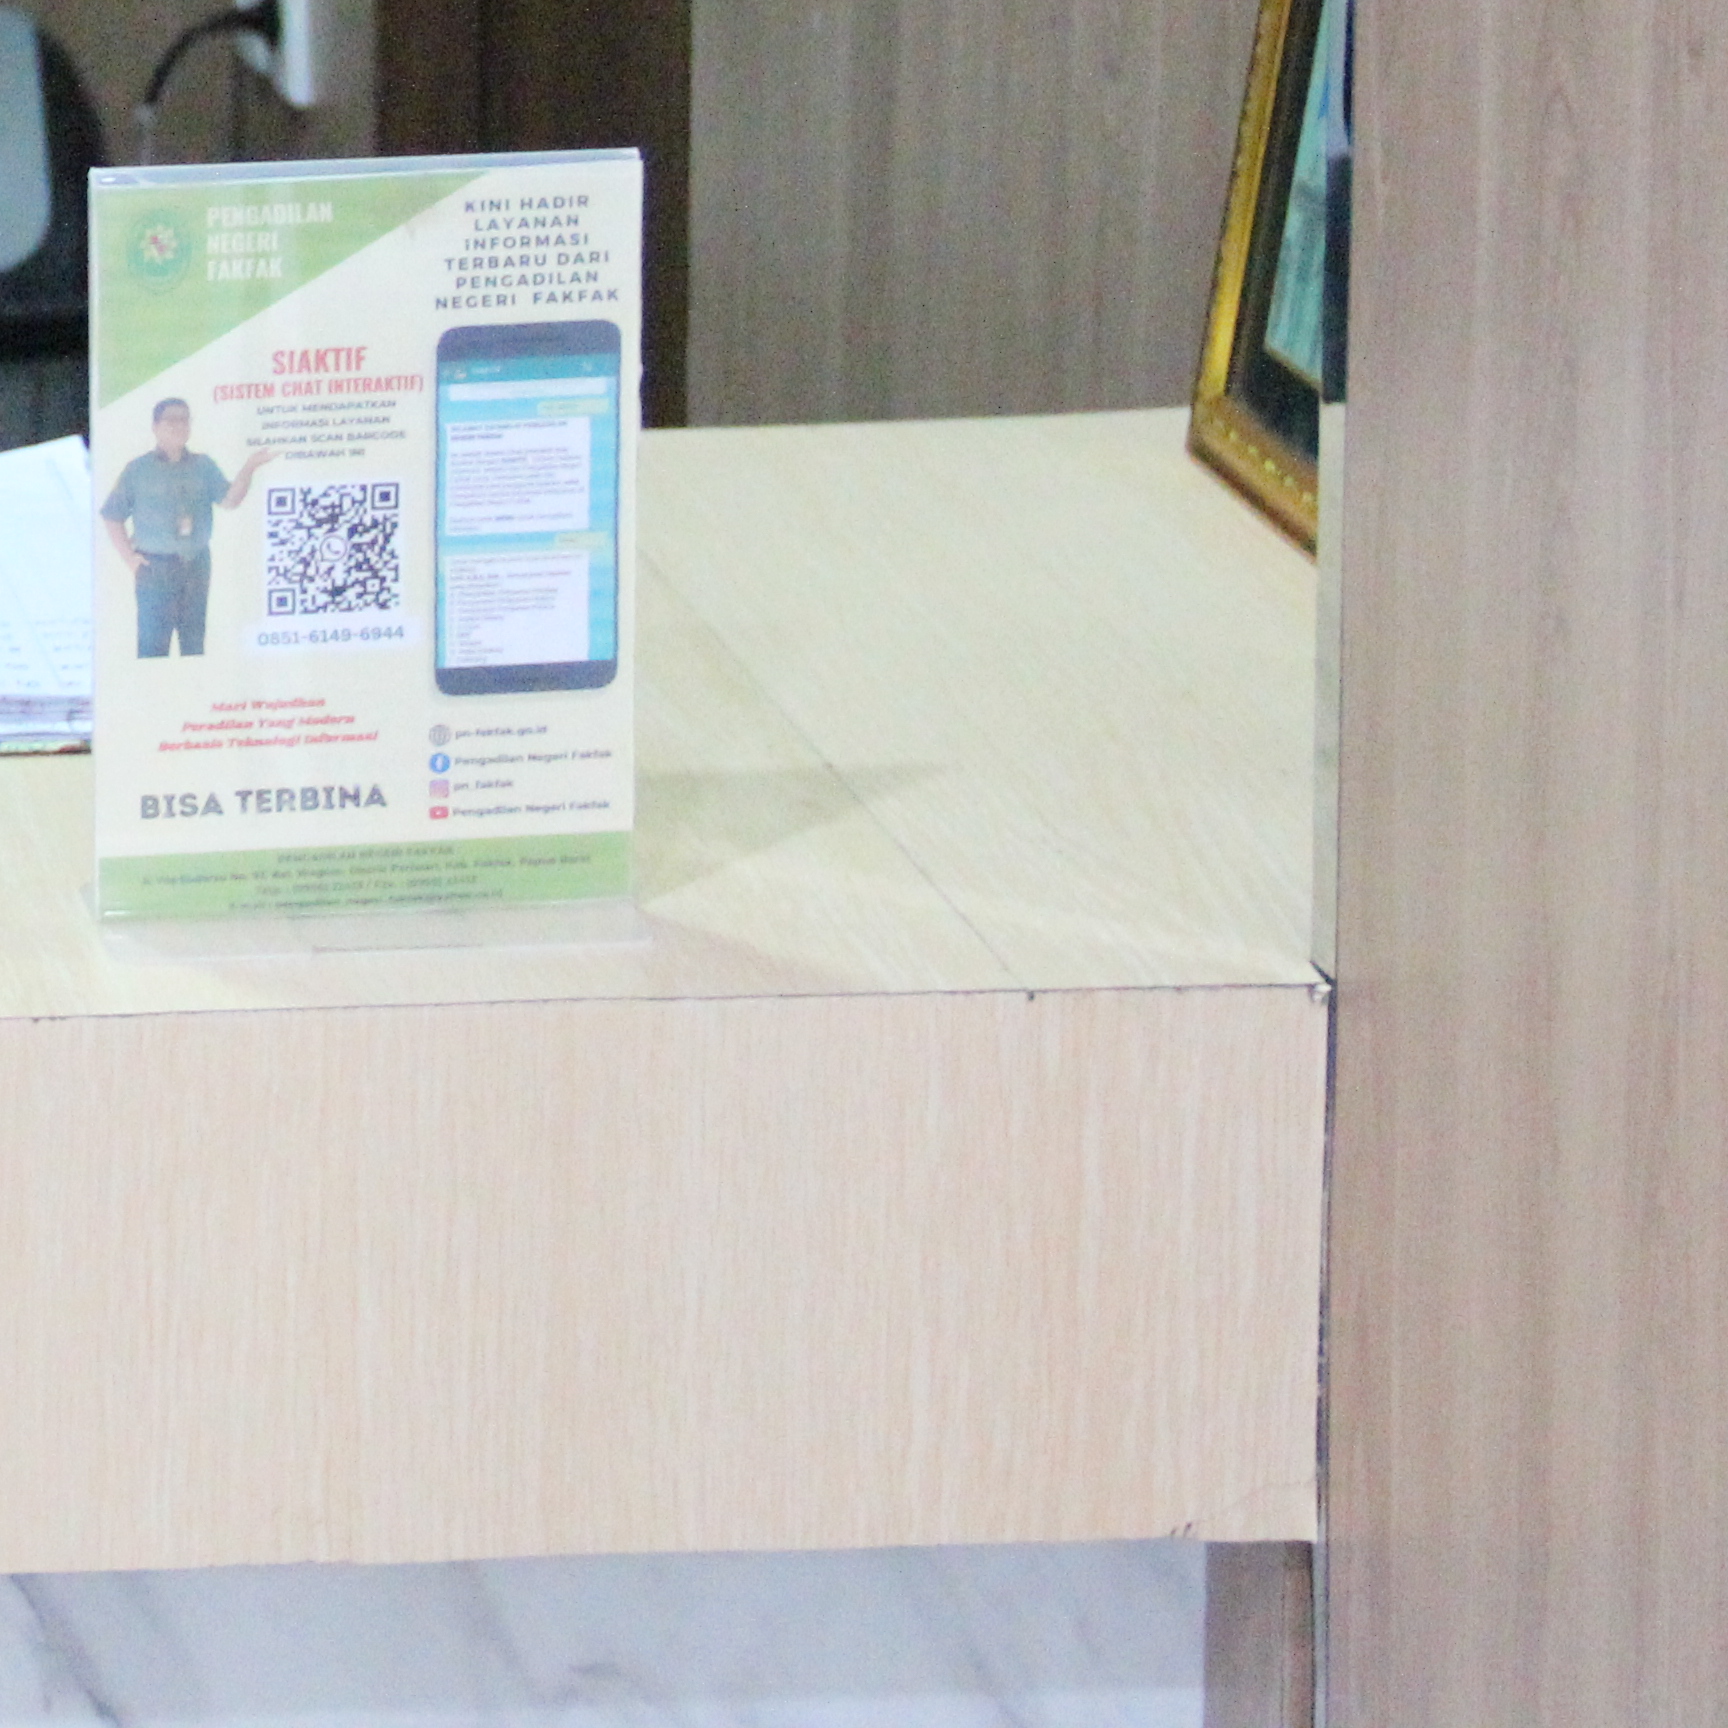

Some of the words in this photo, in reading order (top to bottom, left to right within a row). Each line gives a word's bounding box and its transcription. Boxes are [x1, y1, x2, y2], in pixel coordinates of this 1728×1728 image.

[464, 198, 510, 213] KINI
[520, 195, 590, 211] HADIR
[207, 201, 334, 228] PENGADILAN
[474, 214, 580, 232] LAYANAN
[207, 230, 279, 254] NEGERI
[465, 233, 589, 251] INFORMASI
[207, 257, 283, 282] FAKFAK
[444, 253, 547, 272] TERBARU
[557, 250, 610, 266] DARI
[456, 270, 599, 290] PENGADILAN
[435, 293, 516, 311] NEGERI
[533, 288, 619, 305] FAKFAK
[272, 346, 369, 376] SIAKTIF
[213, 383, 275, 404] (SISTEM
[282, 379, 323, 398] CHAT
[328, 374, 424, 394] INTERAKTIF)
[256, 404, 298, 416] UNTUK
[302, 400, 397, 412] MENDAPATKAN
[261, 418, 330, 430] INFORMASI
[332, 415, 391, 427] LAYANAN
[311, 432, 343, 443] SCAN
[346, 430, 406, 441] BARCODE
[285, 448, 345, 460] DIBAWAH
[257, 626, 405, 647] 0851-6149-6944
[259, 718, 296, 730] Yang
[140, 791, 224, 820] BISA
[234, 783, 388, 815] TERBINA
